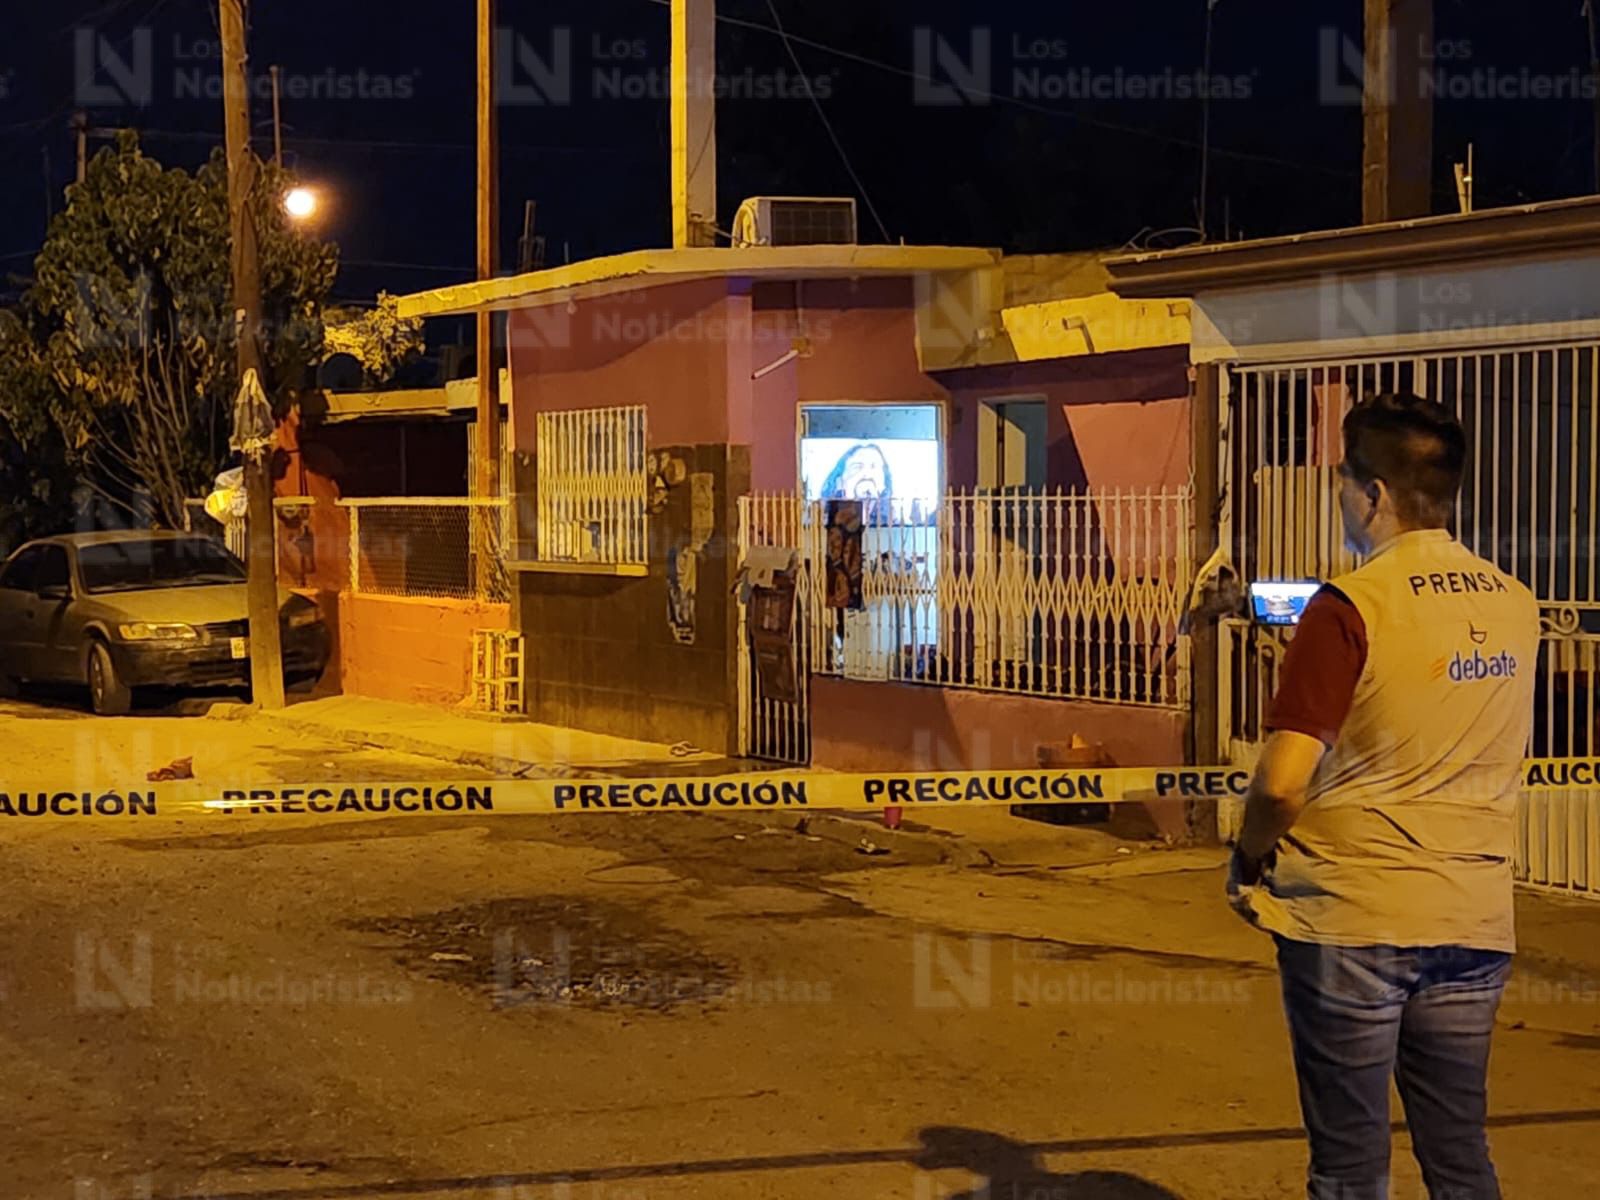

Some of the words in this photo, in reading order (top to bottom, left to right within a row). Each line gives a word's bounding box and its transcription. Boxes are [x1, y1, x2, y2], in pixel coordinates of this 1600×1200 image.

[1409, 571, 1508, 597] PRENSA
[1448, 649, 1517, 682] debate
[222, 784, 492, 815] PRECAUCIÓN
[554, 779, 808, 809] PRECAUCIÓN
[863, 773, 1103, 803] PRECAUCIÓN
